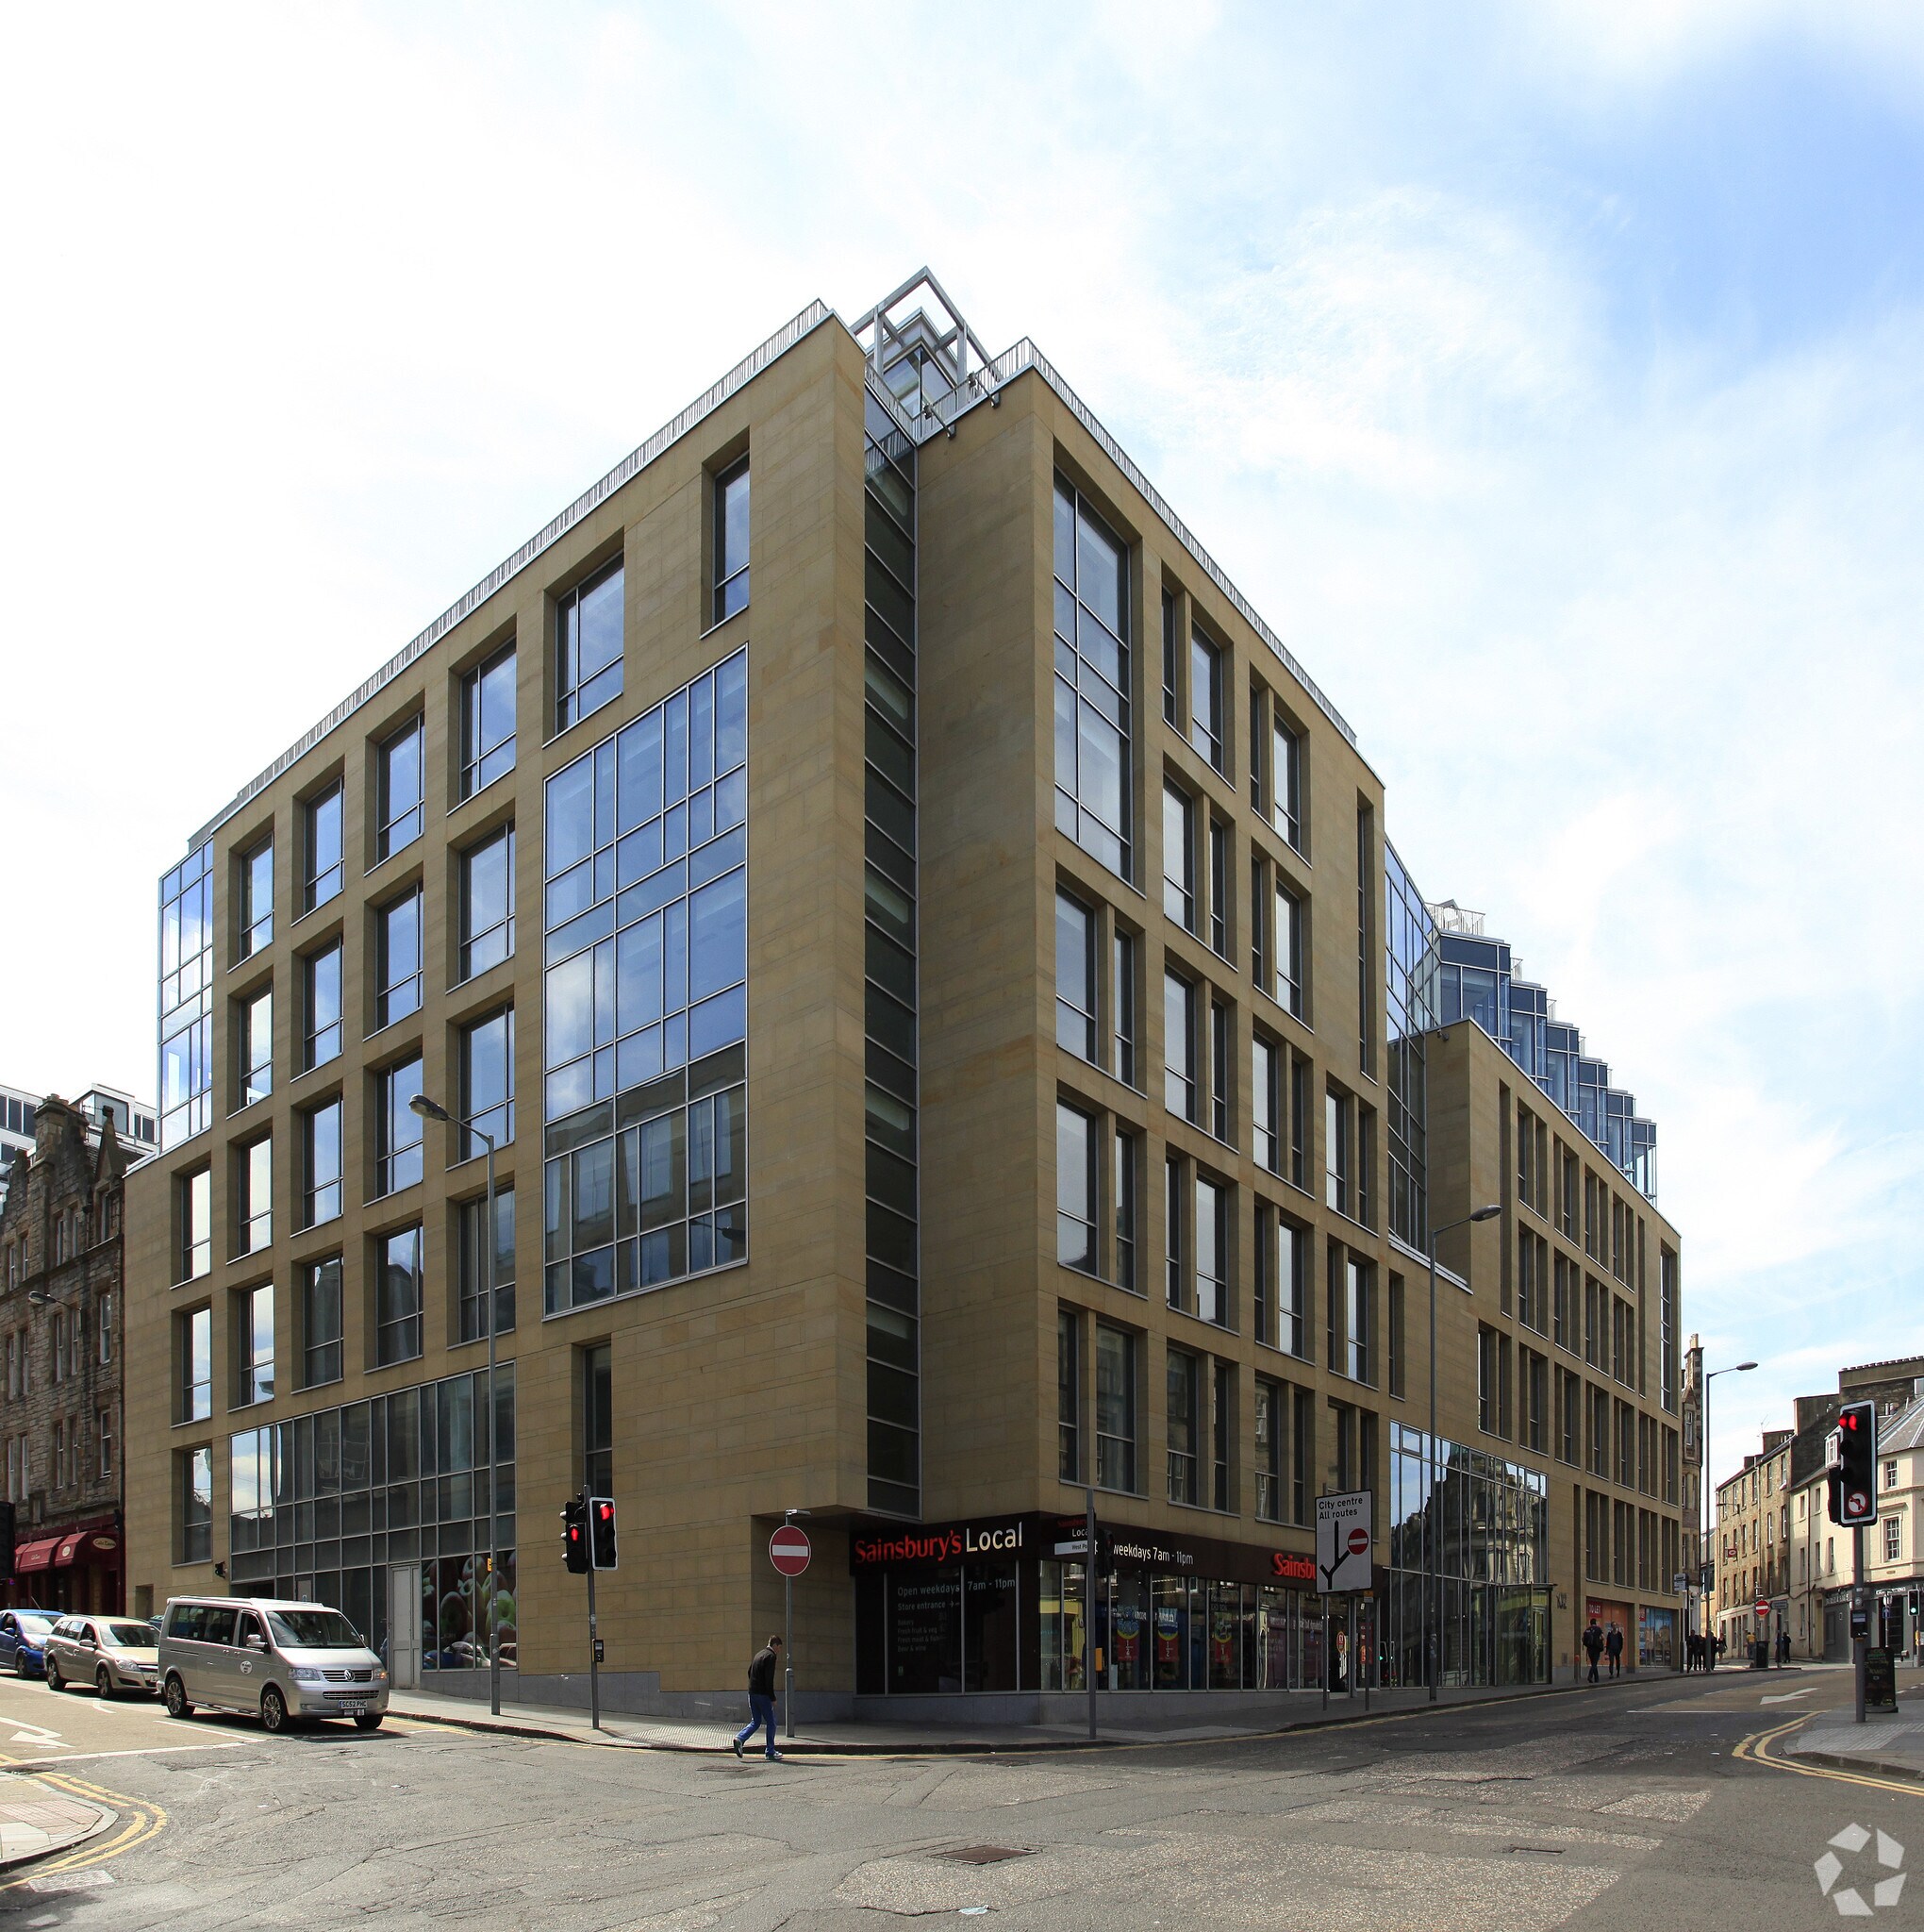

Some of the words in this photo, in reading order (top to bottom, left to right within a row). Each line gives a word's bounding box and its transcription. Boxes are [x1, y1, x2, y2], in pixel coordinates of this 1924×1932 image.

[1319, 1501, 1335, 1510] City
[1337, 1497, 1363, 1507] centre
[1319, 1511, 1330, 1520] All
[1332, 1508, 1358, 1518] routes
[1071, 1528, 1088, 1537] Loca
[854, 1529, 962, 1563] Sainsbury's
[966, 1522, 1022, 1553] Local
[1153, 1546, 1170, 1562] 7am
[1176, 1550, 1194, 1566] 11pm
[897, 1586, 918, 1598] Open
[920, 1583, 960, 1595] weekdays
[967, 1580, 987, 1591] 7am
[995, 1577, 1016, 1590] 11pm
[898, 1602, 916, 1611] Store
[917, 1600, 946, 1610] entrance
